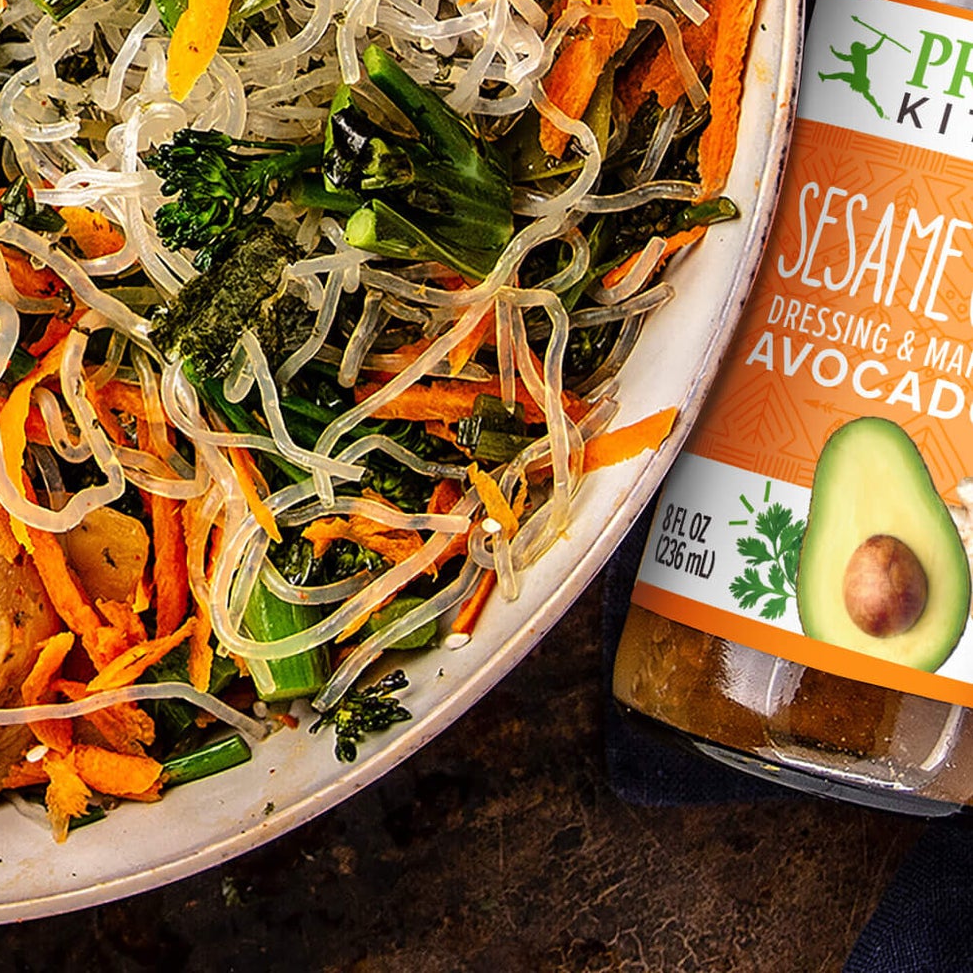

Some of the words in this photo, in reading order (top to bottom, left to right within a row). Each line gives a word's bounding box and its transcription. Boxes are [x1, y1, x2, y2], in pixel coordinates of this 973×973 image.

[777, 181, 973, 322] SESAME
[767, 295, 891, 354] DRESSING
[896, 330, 915, 363] &
[745, 331, 973, 421] AVOCAD
[655, 533, 687, 570] (236
[684, 549, 716, 579] mL)
[662, 502, 675, 533] 8
[670, 506, 688, 538] FL
[689, 512, 712, 544] OZ
